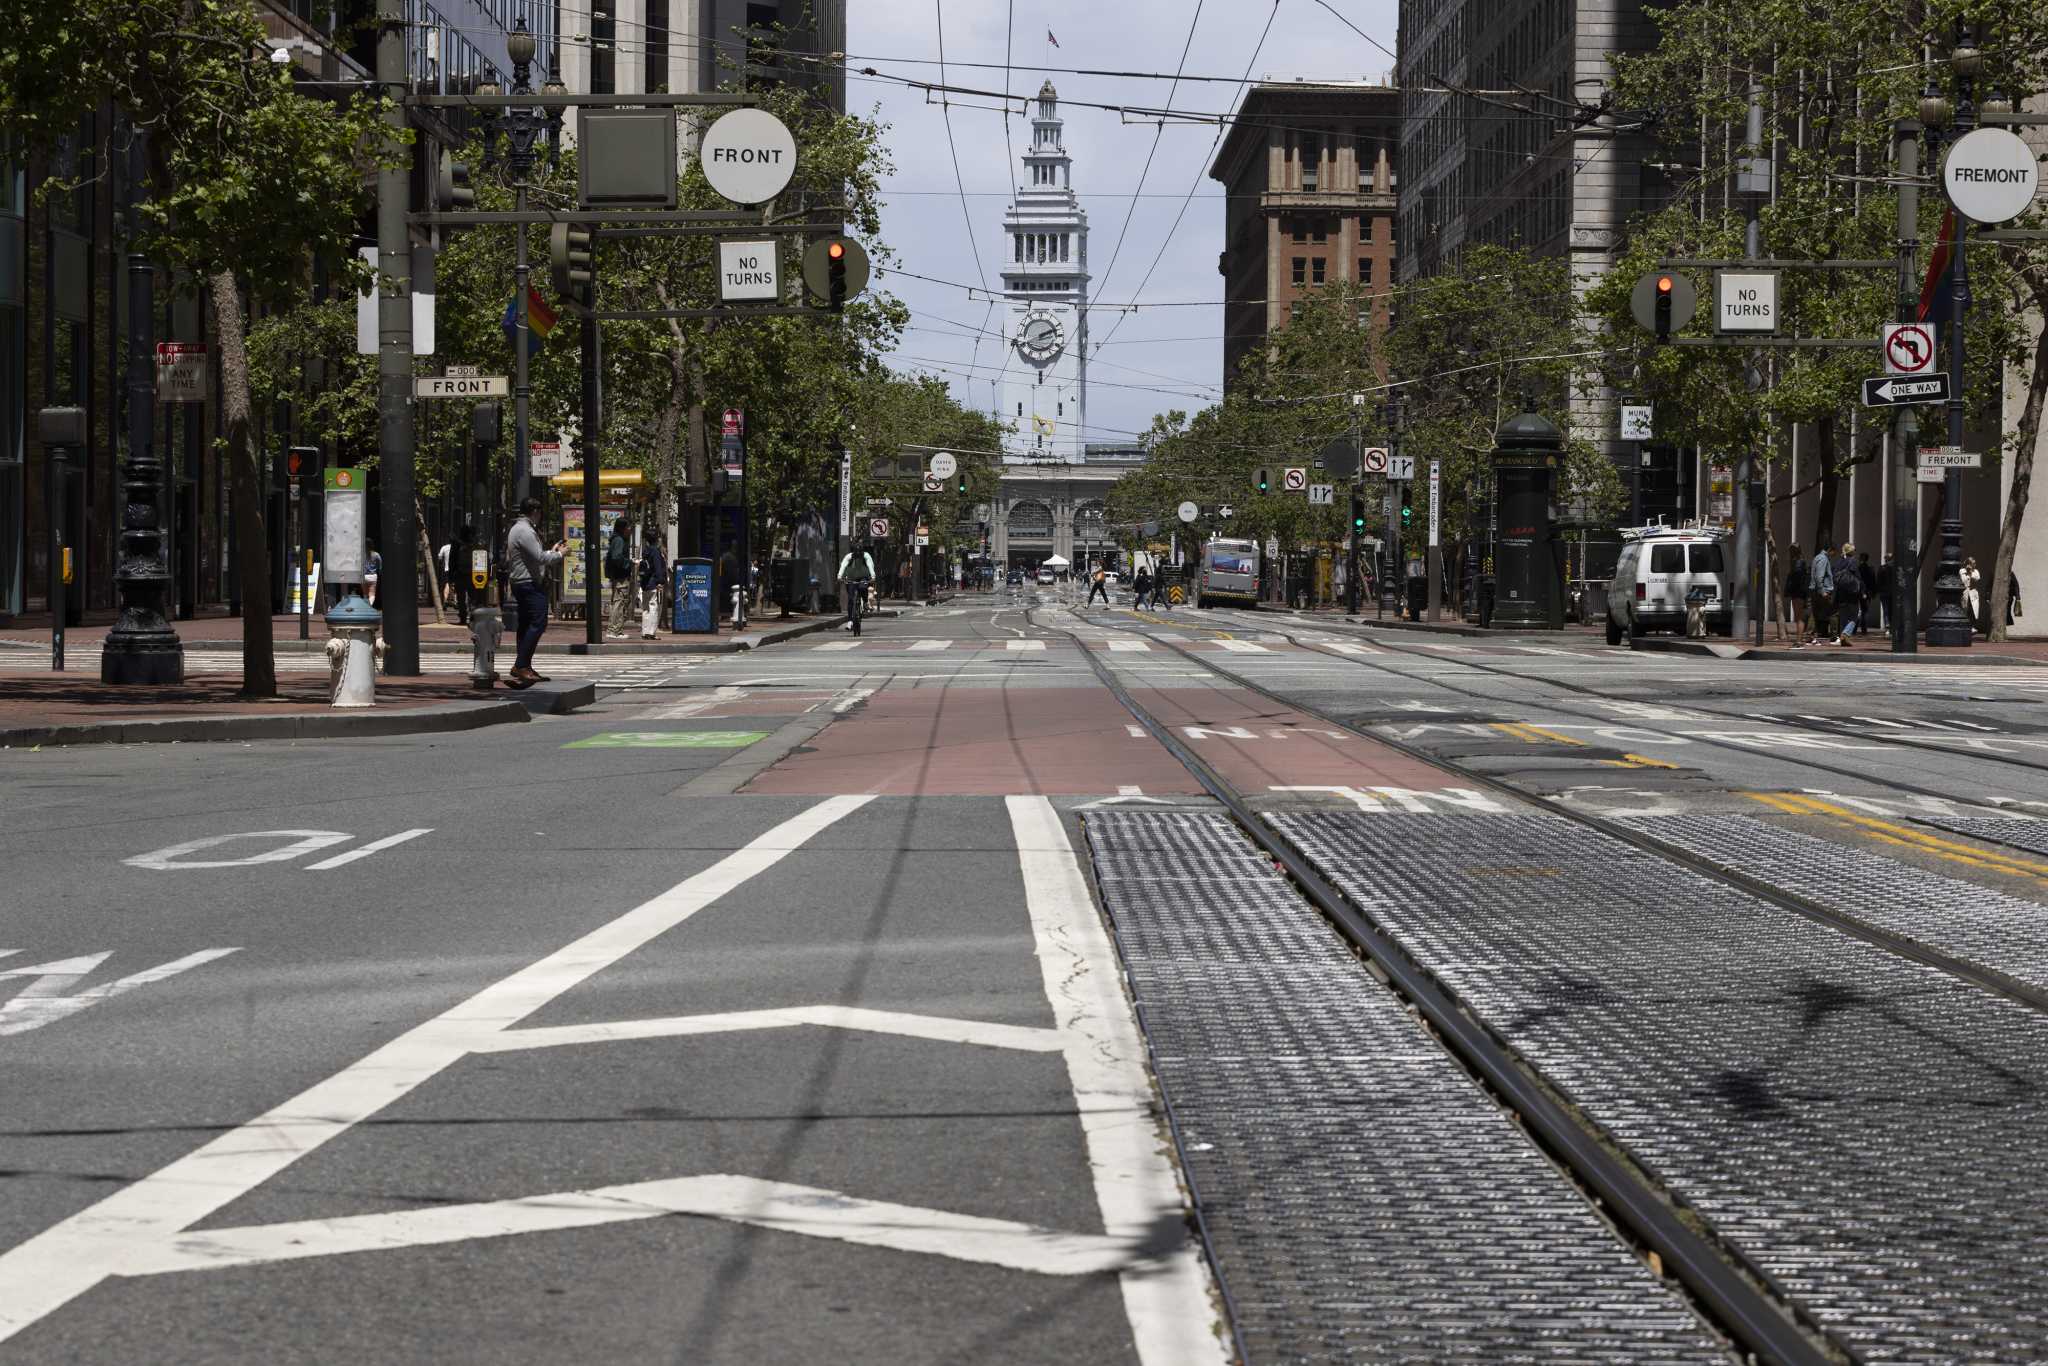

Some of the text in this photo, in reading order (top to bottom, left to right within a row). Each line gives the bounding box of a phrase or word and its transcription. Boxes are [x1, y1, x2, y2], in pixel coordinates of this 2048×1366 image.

[713, 148, 783, 164] FRONT
[1954, 168, 2030, 184] FREMONT
[739, 257, 758, 270] NO
[726, 272, 772, 286] TURNS
[1738, 289, 1757, 302] NO
[1726, 304, 1770, 317] TURNS
[159, 353, 174, 365] NO
[173, 369, 193, 379] ANY
[171, 379, 196, 389] TIME
[433, 380, 491, 393] FRONT
[1891, 382, 1938, 395] ONE WAY
[1928, 456, 1972, 465] FREMONT
